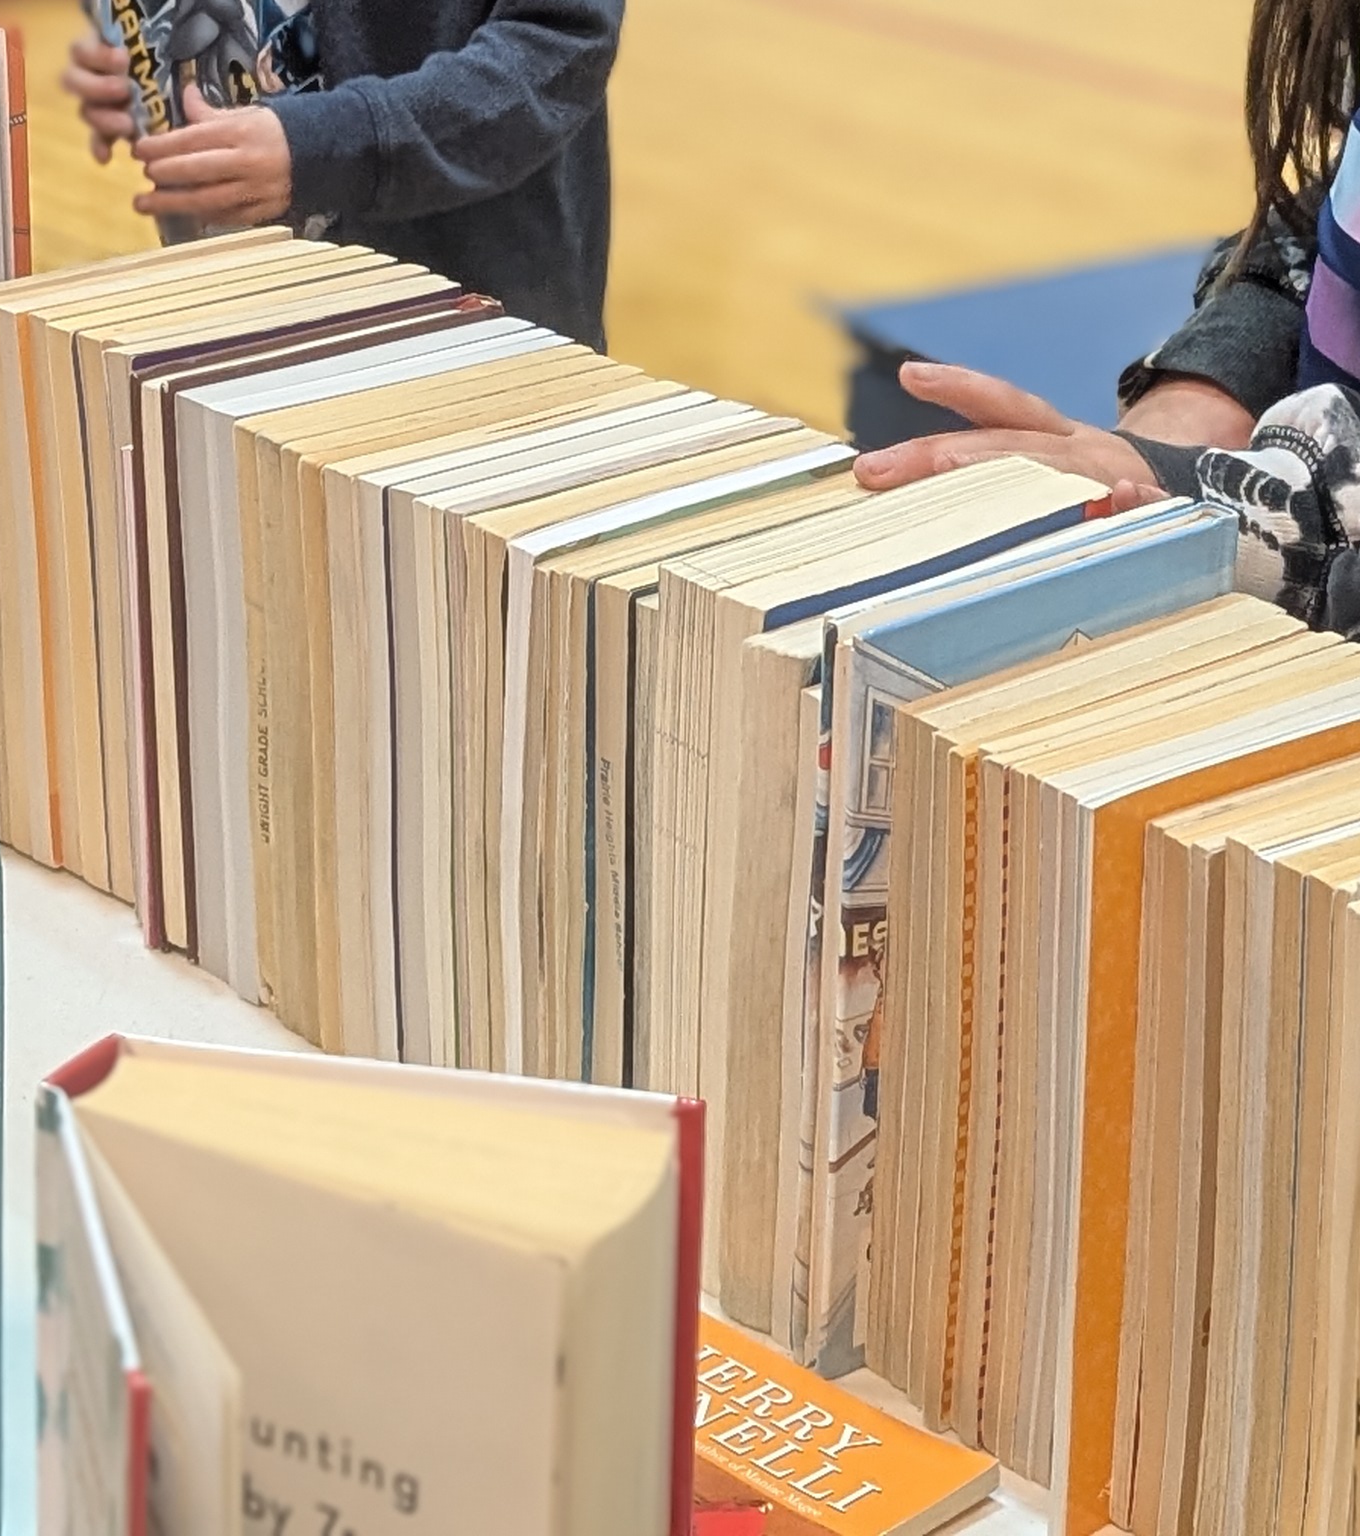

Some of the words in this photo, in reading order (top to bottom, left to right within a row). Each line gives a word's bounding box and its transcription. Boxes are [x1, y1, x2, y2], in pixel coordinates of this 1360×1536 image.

[258, 724, 269, 777] GRADE
[696, 1441, 729, 1464] uthor
[742, 1465, 785, 1497] Maniac
